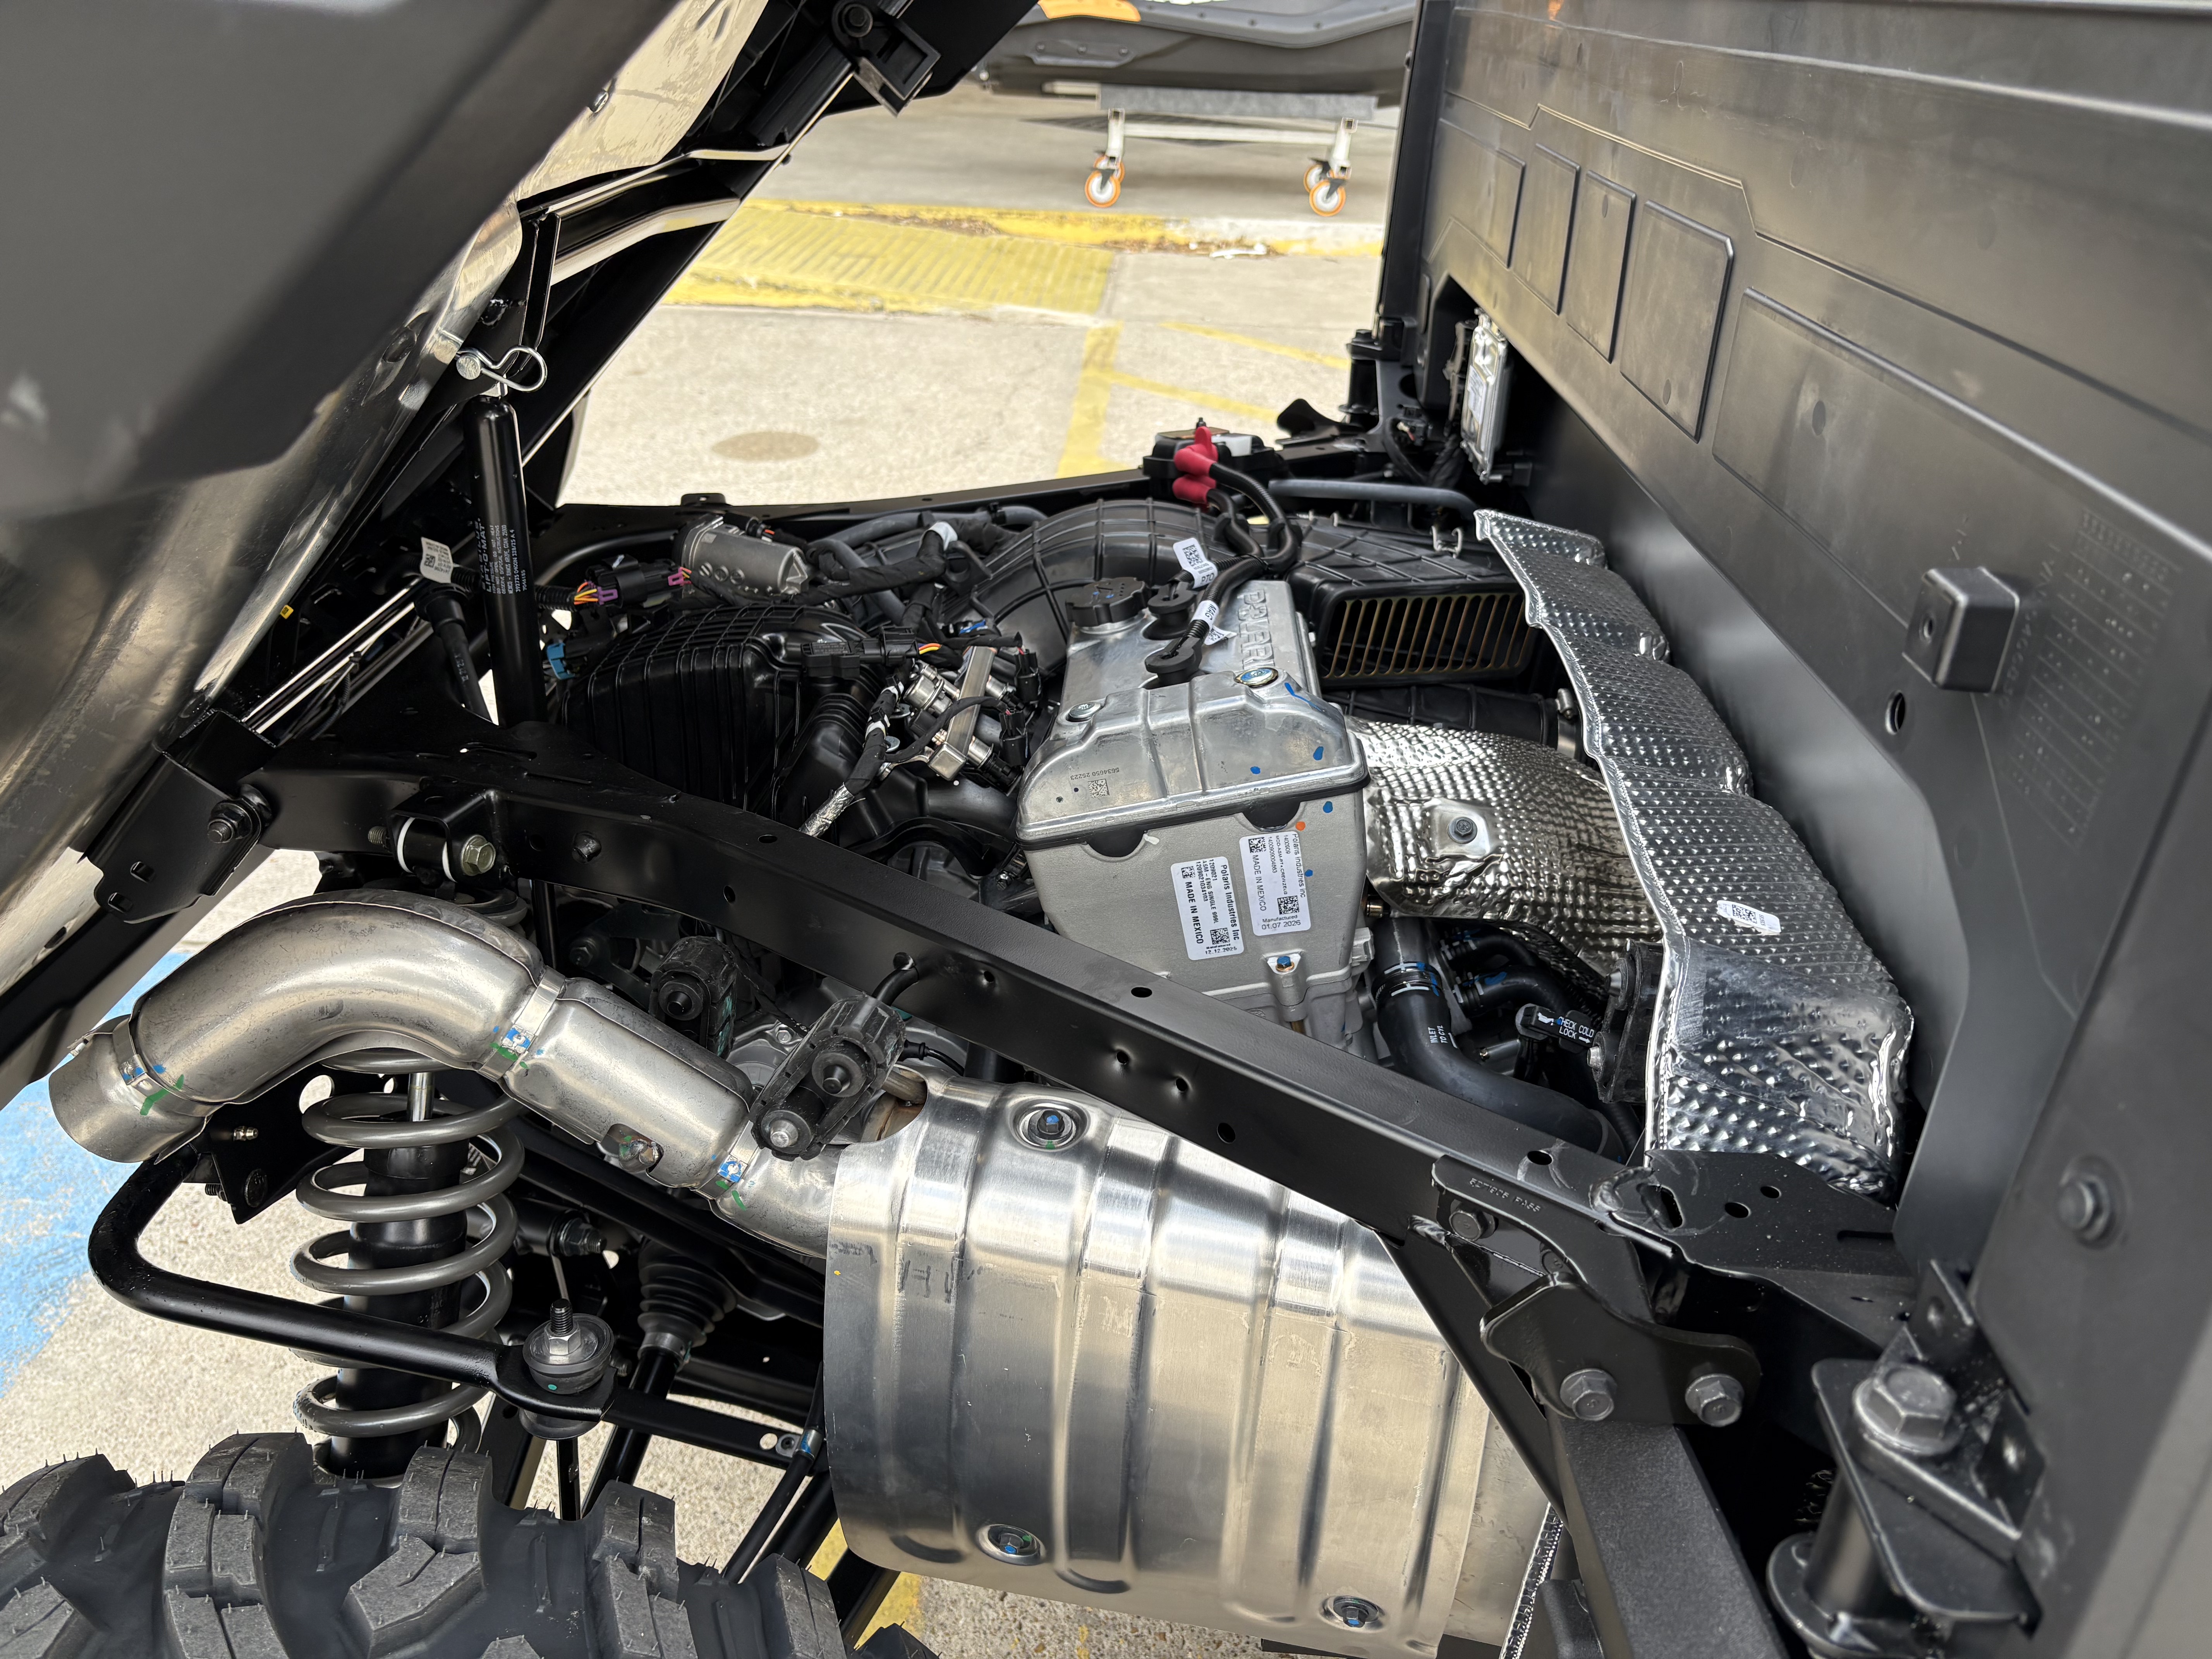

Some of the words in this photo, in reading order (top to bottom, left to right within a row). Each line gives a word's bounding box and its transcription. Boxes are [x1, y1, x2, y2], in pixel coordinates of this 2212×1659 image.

[1205, 603, 1217, 620] MAG
[1237, 589, 1275, 670] POLARI
[1295, 857, 1304, 887] Industries
[1252, 855, 1261, 875] MADE
[1257, 885, 1266, 911] MEXICO
[1221, 864, 1230, 890] Polaris
[1226, 891, 1237, 928] Industries
[1185, 881, 1196, 903] MADE
[1192, 916, 1204, 944] MEXICO
[1262, 915, 1297, 923] Manufactured
[1428, 1027, 1437, 1044] INLET
[1440, 1036, 1447, 1044] TO
[1559, 1026, 1577, 1039] LOCK
[1578, 1025, 1594, 1038] COLD
